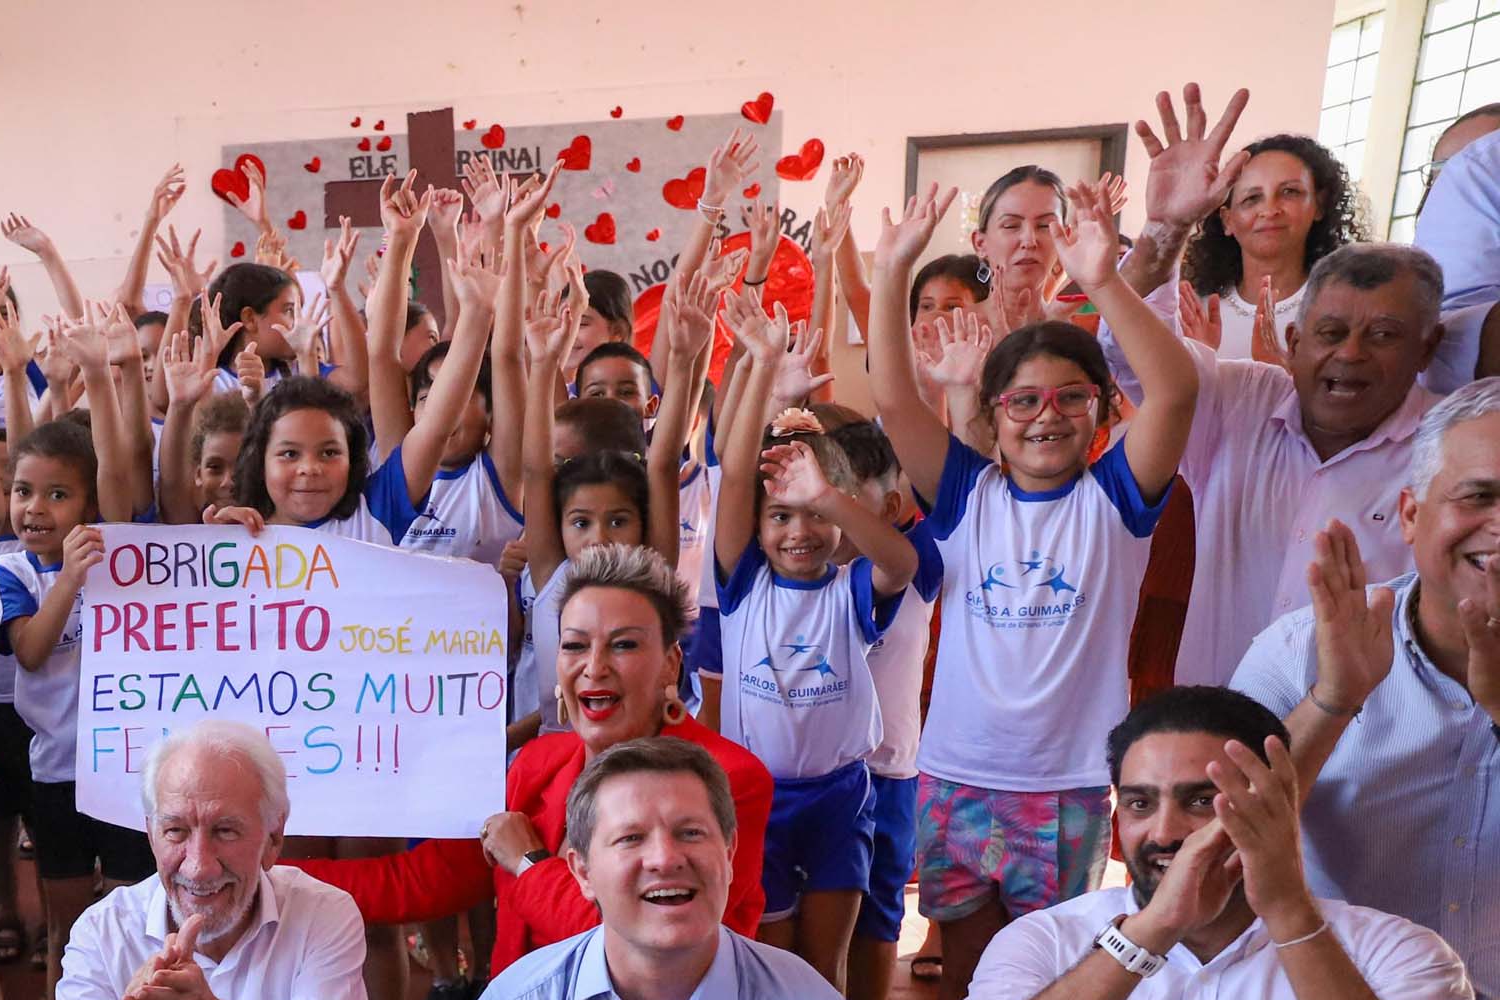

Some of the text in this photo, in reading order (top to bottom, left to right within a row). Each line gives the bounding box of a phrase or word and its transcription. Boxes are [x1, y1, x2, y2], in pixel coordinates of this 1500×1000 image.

[349, 155, 398, 179] ELE
[109, 542, 339, 590] OBRIGADA
[339, 617, 414, 654] JOSÉ
[92, 670, 504, 716] ESTAMOS MUITO
